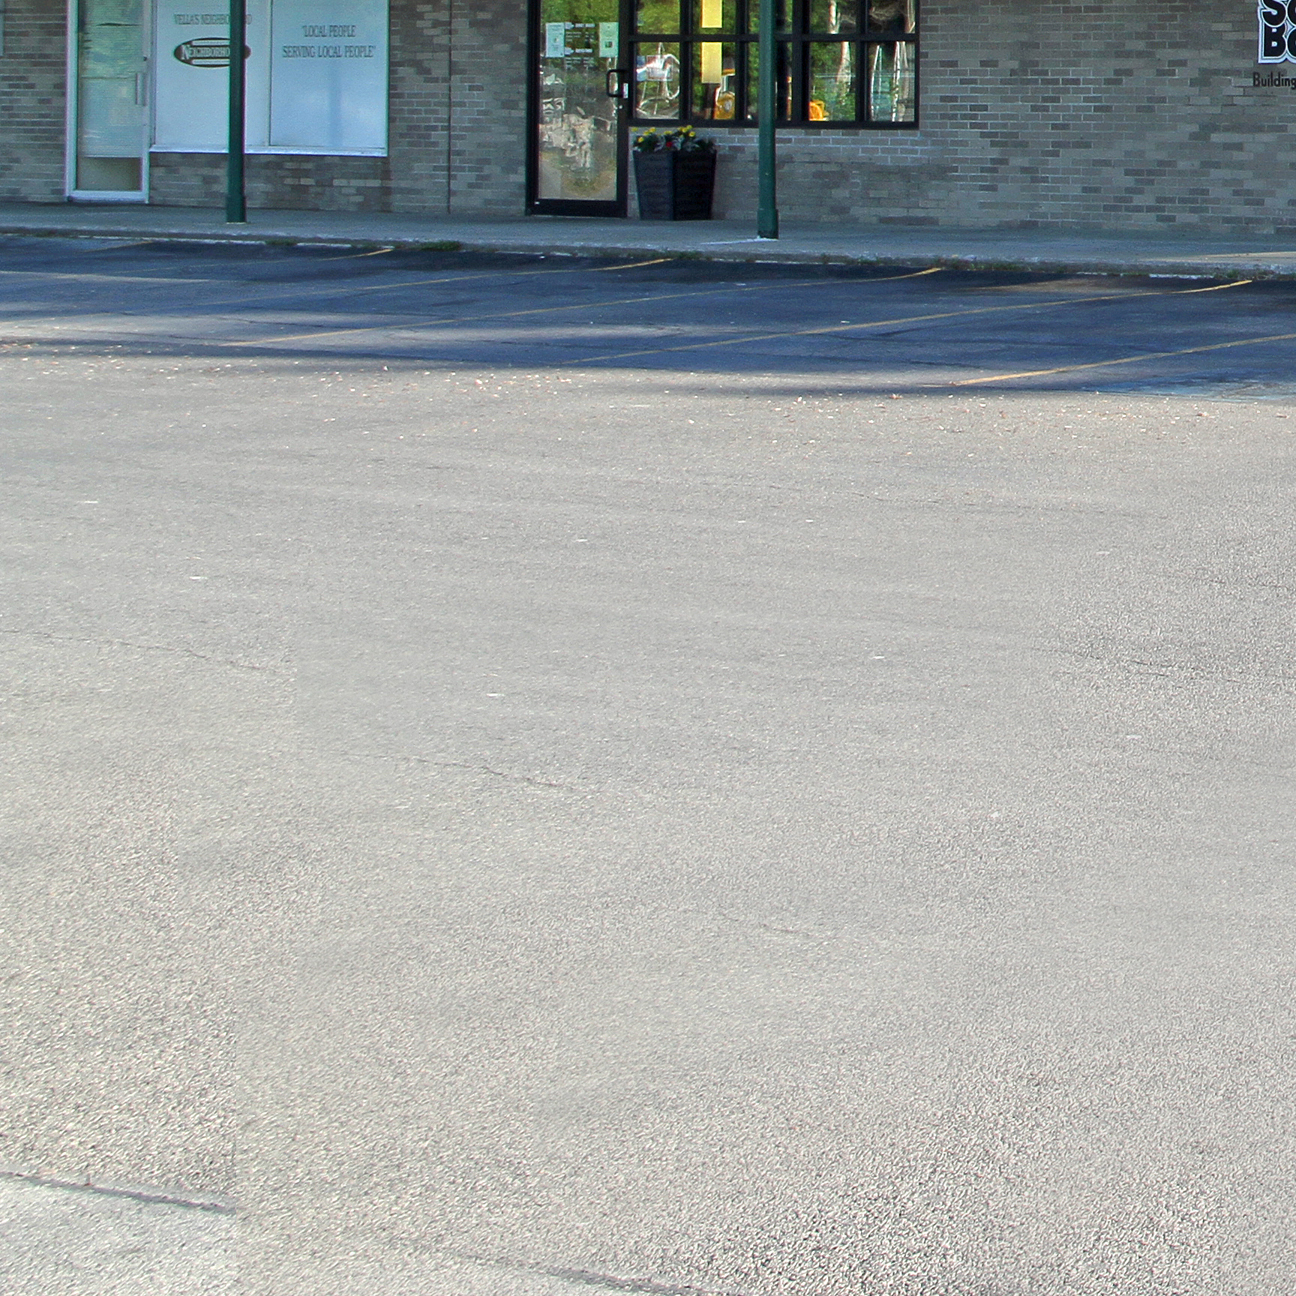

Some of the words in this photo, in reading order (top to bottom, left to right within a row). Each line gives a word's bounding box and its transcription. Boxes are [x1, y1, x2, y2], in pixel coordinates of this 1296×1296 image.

[329, 25, 356, 38] PEOPLE
[282, 45, 315, 58] SERVING
[318, 45, 343, 58] LOCAL
[1252, 71, 1296, 91] Building
